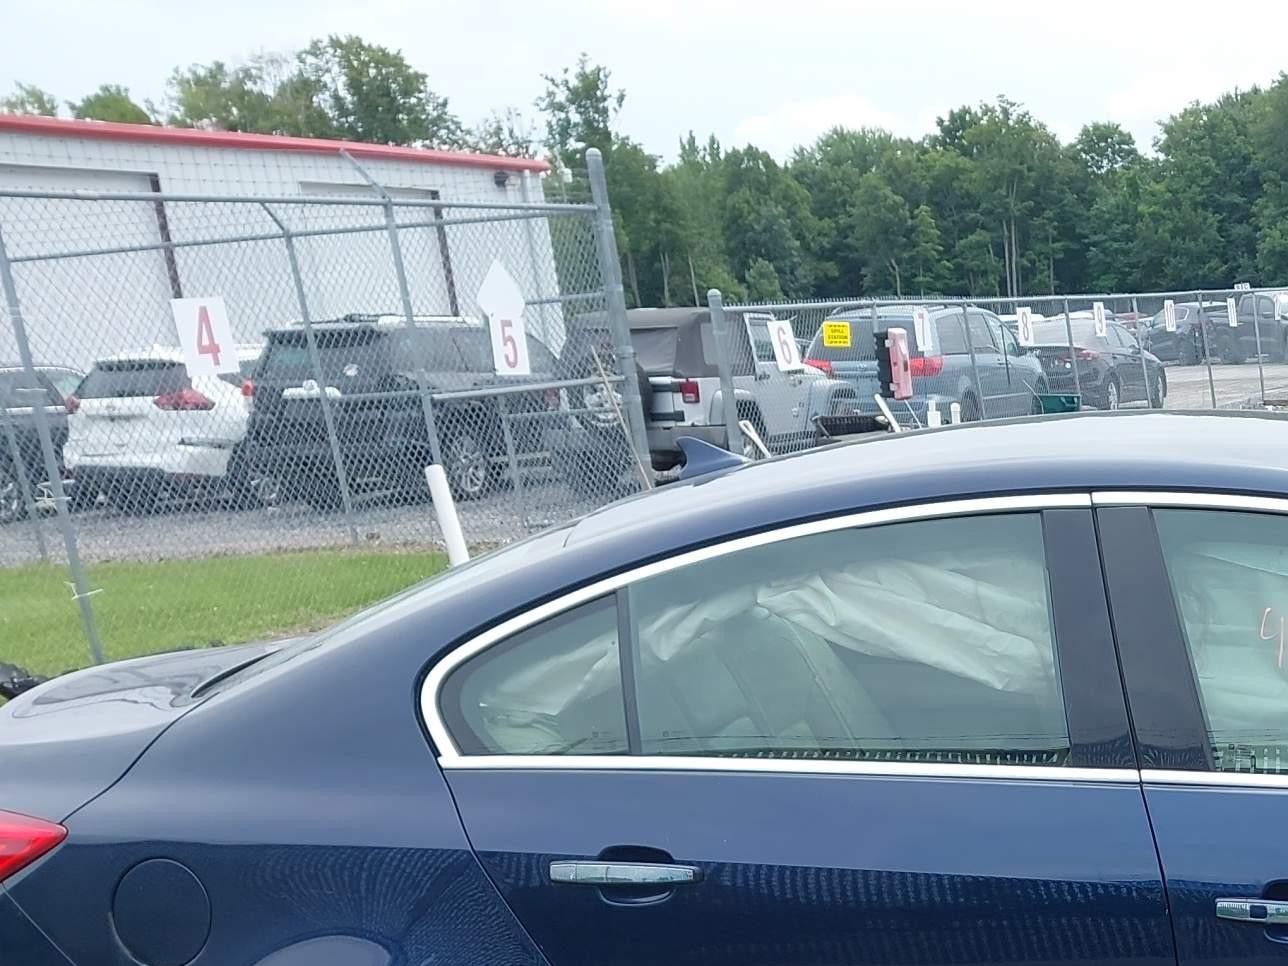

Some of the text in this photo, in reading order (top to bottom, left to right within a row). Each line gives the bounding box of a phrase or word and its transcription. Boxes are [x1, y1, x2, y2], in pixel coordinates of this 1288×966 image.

[196, 305, 221, 366] 4
[917, 312, 927, 344] 7
[1021, 311, 1030, 342] 8
[1097, 305, 1104, 334] 9
[500, 319, 519, 369] 5
[776, 326, 793, 365] 6
